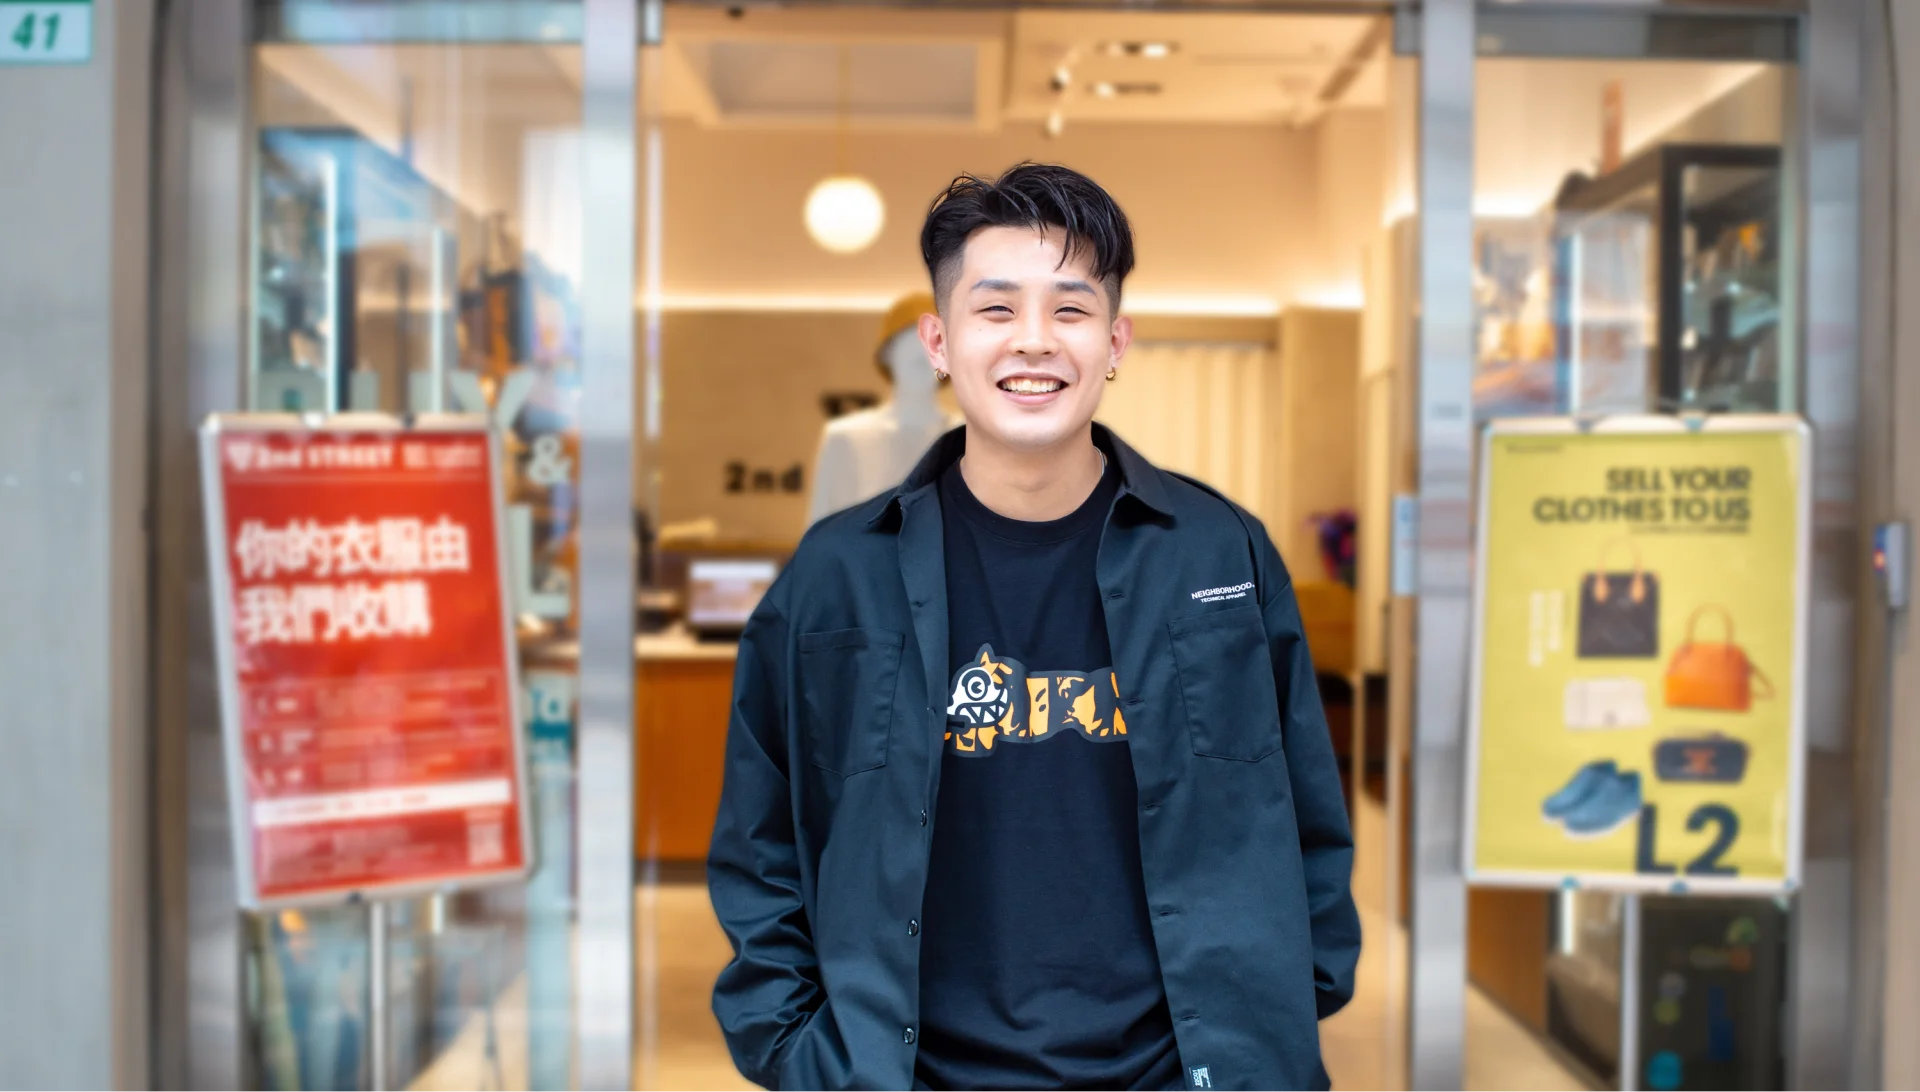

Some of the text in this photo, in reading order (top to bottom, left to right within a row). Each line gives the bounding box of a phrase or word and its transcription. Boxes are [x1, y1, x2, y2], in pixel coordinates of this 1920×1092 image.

[11, 12, 60, 50] 41
[724, 461, 804, 494] 2nd
[1605, 465, 1753, 492] SELL YOUR
[1532, 495, 1753, 524] CLOTHES TO US
[235, 517, 470, 578] 你的衣服由
[239, 581, 432, 646] 我們收購
[1200, 592, 1246, 603] TECHNICAL APPAREL
[1634, 802, 1742, 876] L2
